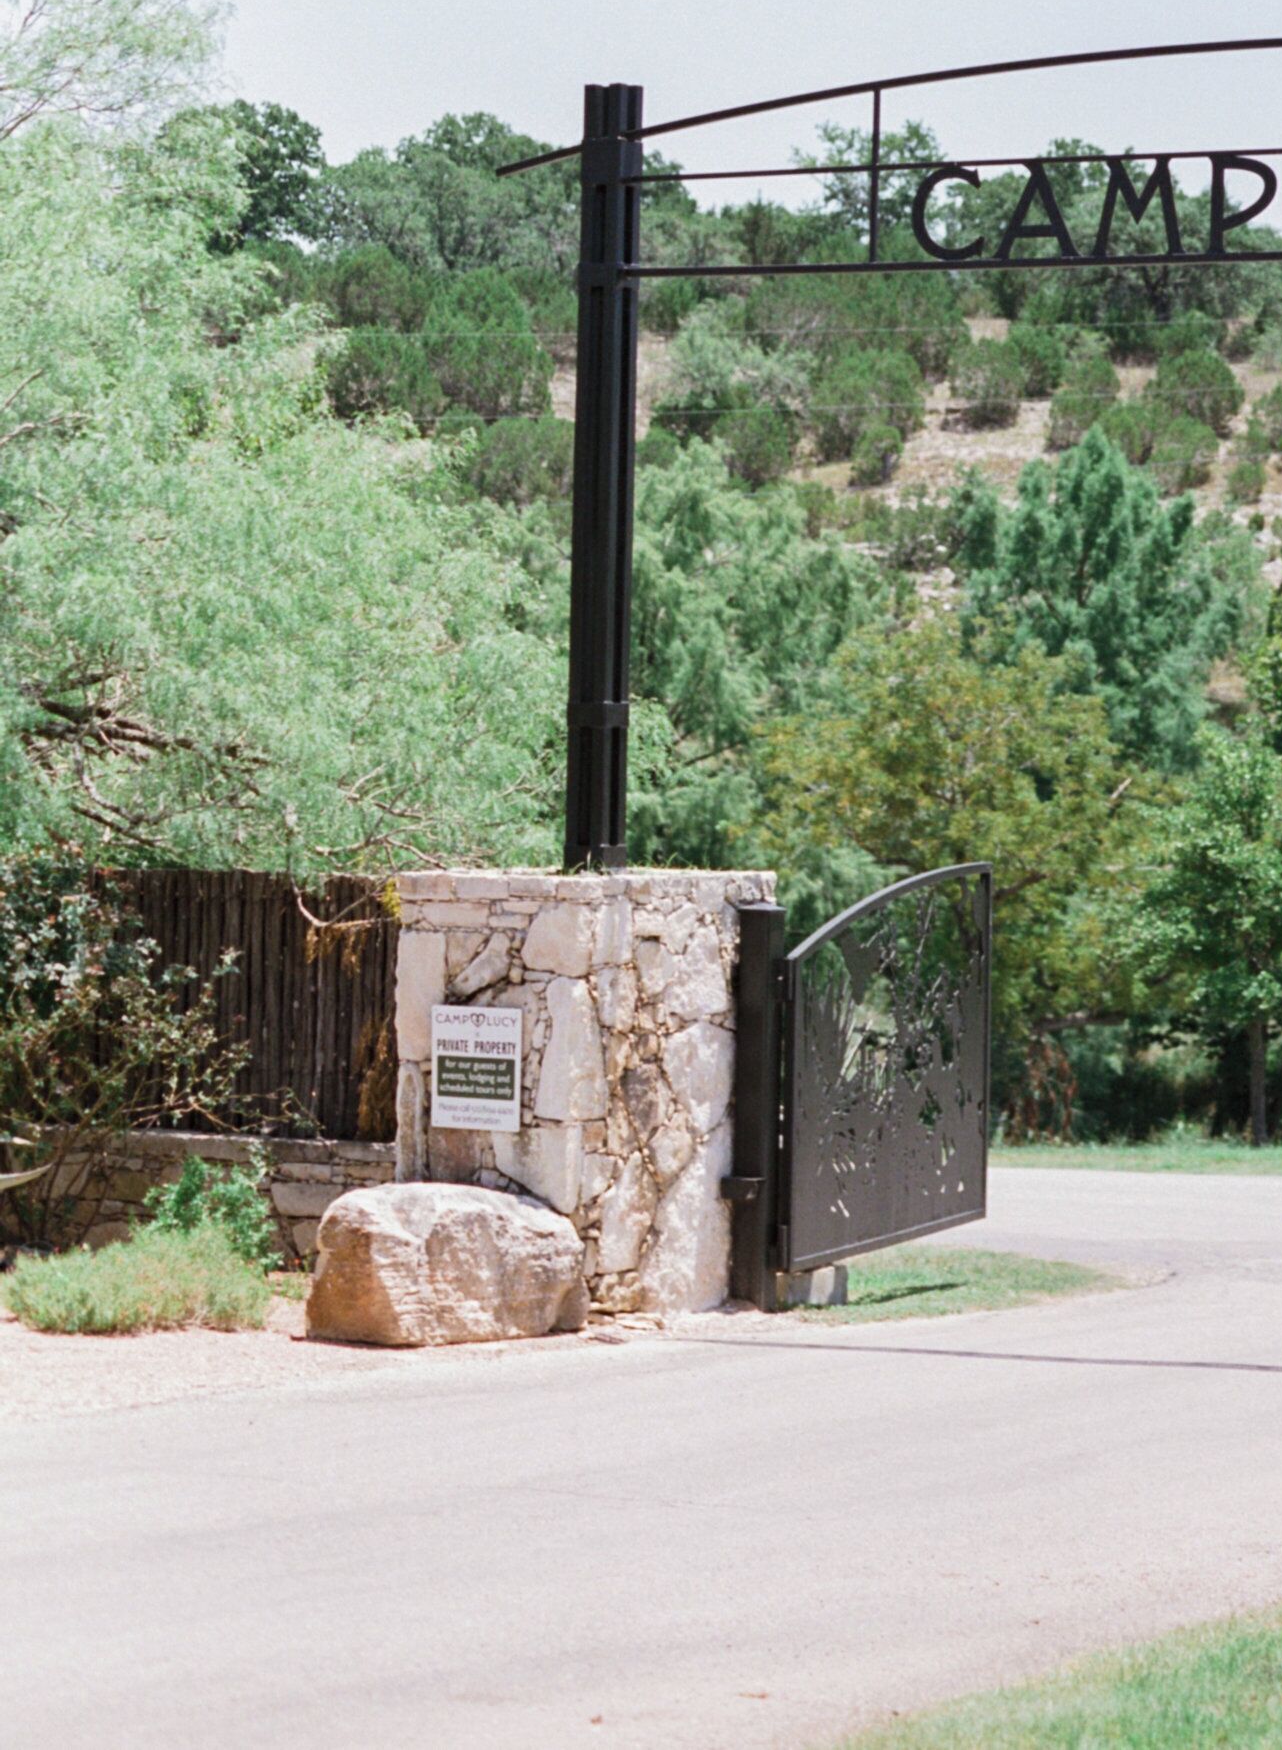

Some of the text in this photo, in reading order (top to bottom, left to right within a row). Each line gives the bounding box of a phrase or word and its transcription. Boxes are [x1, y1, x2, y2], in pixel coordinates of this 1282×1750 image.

[912, 155, 1277, 261] CAMP
[435, 1012, 517, 1027] CAMP LUCY
[436, 1038, 516, 1054] PRIVATE PROPERTY
[445, 1058, 507, 1072] for our guests of
[441, 1072, 511, 1085] events, lodging and
[439, 1082, 512, 1098] scheduled tours only
